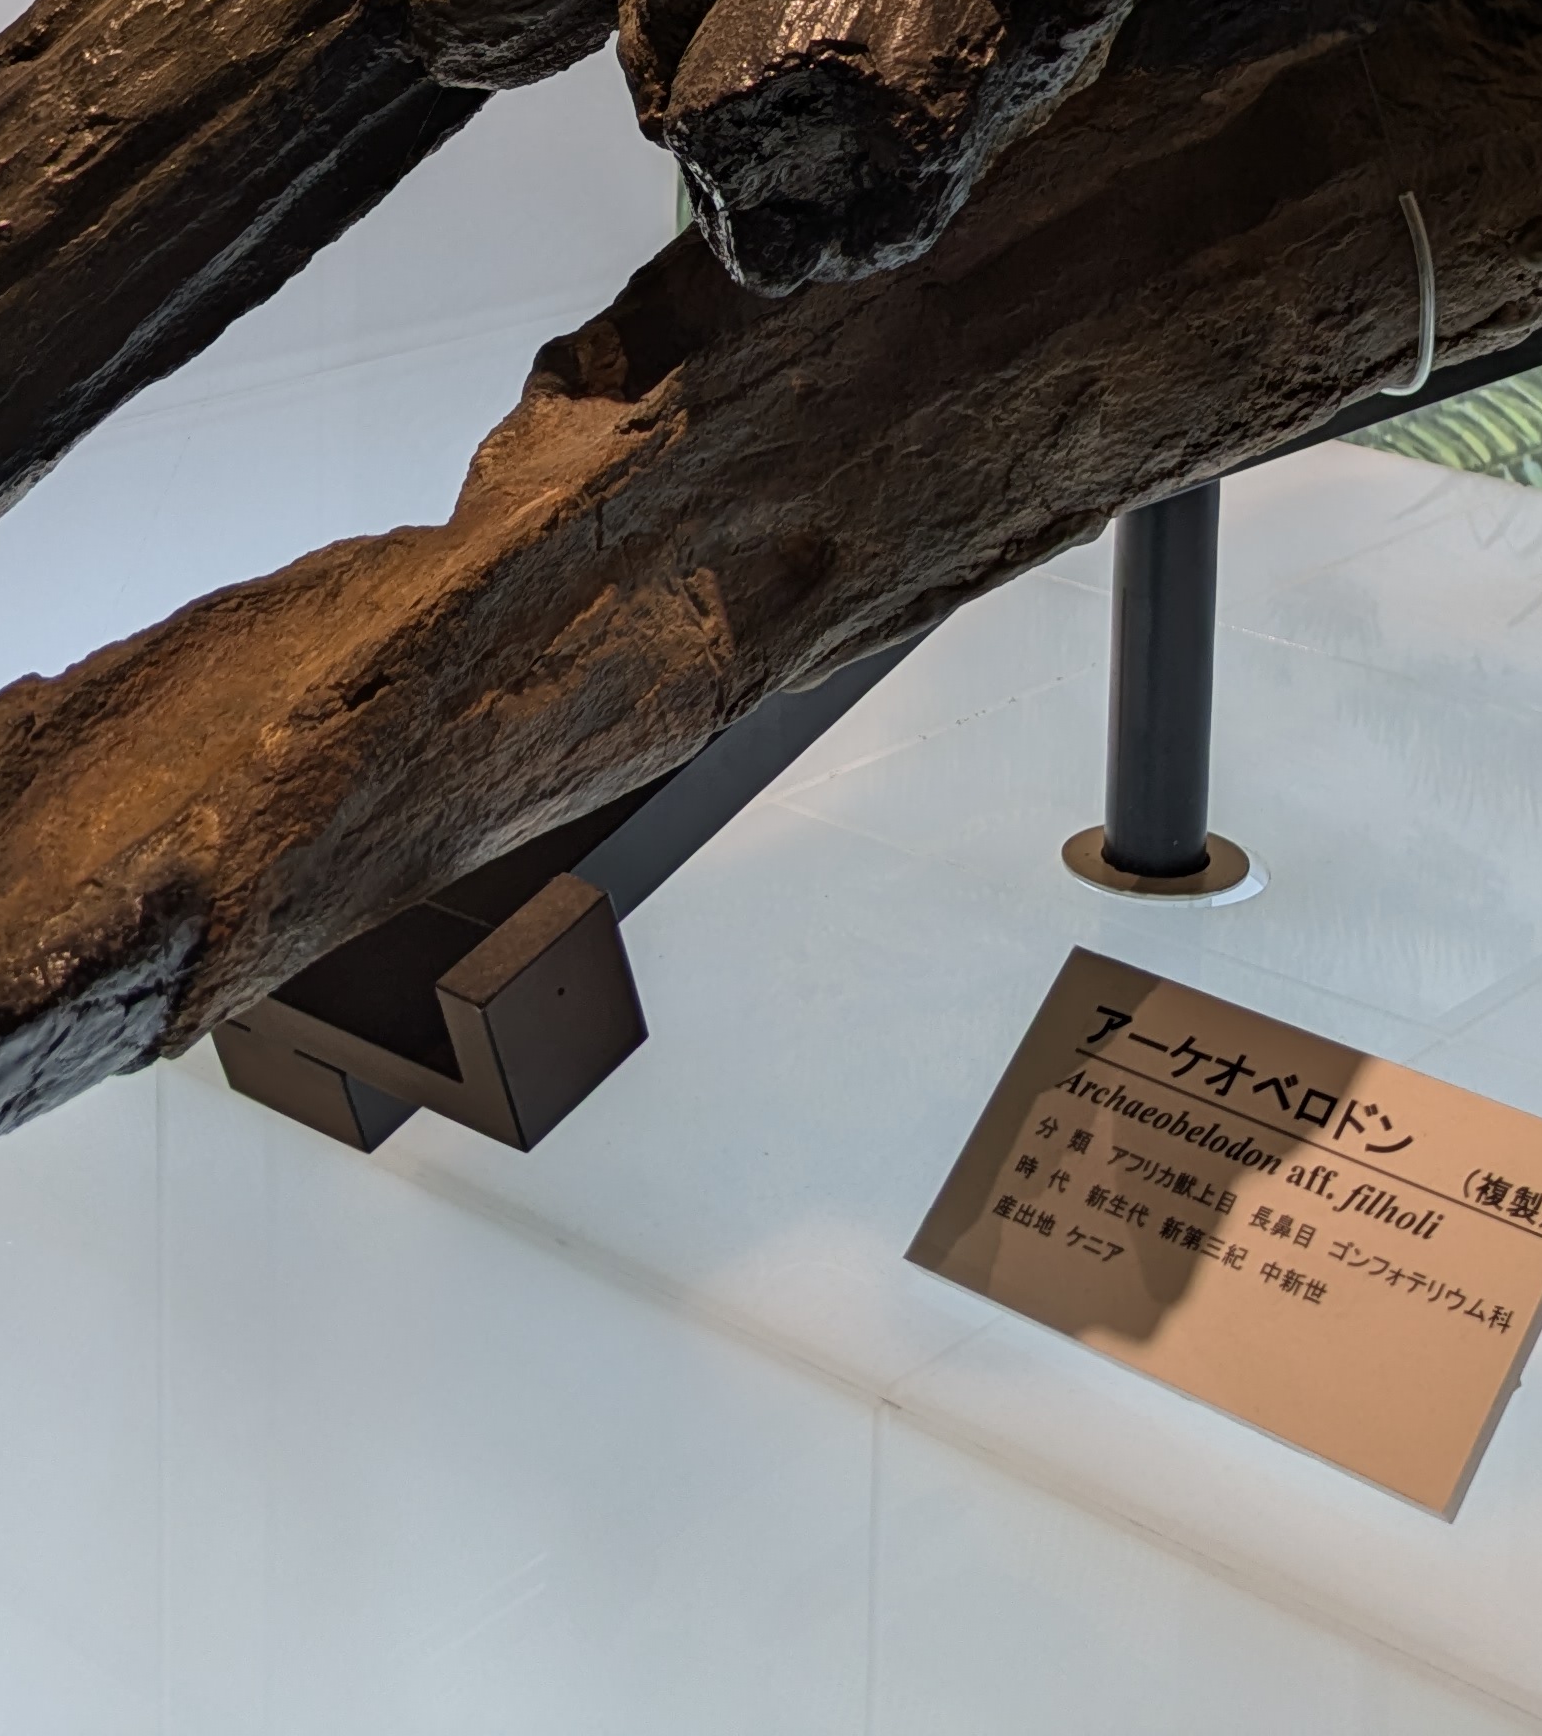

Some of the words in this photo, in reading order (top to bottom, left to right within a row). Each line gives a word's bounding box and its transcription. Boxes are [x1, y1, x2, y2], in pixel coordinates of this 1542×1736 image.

[1086, 1005, 1414, 1154] アーケオベロドン
[992, 1193, 1056, 1238] 産出地
[1065, 1225, 1125, 1263] ケニア
[1055, 1069, 1283, 1176] Archaeobelodon
[1285, 1164, 1339, 1200] aff.
[1332, 1183, 1446, 1240] filholi
[1084, 1183, 1150, 1228] 新生代
[1159, 1215, 1249, 1271] 新第三紀
[1260, 1261, 1328, 1306] 中新世
[1107, 1145, 1238, 1216] アフリカ獣上目
[1248, 1206, 1316, 1250] 長鼻目
[1328, 1240, 1515, 1334] ゴンフォテリウム科
